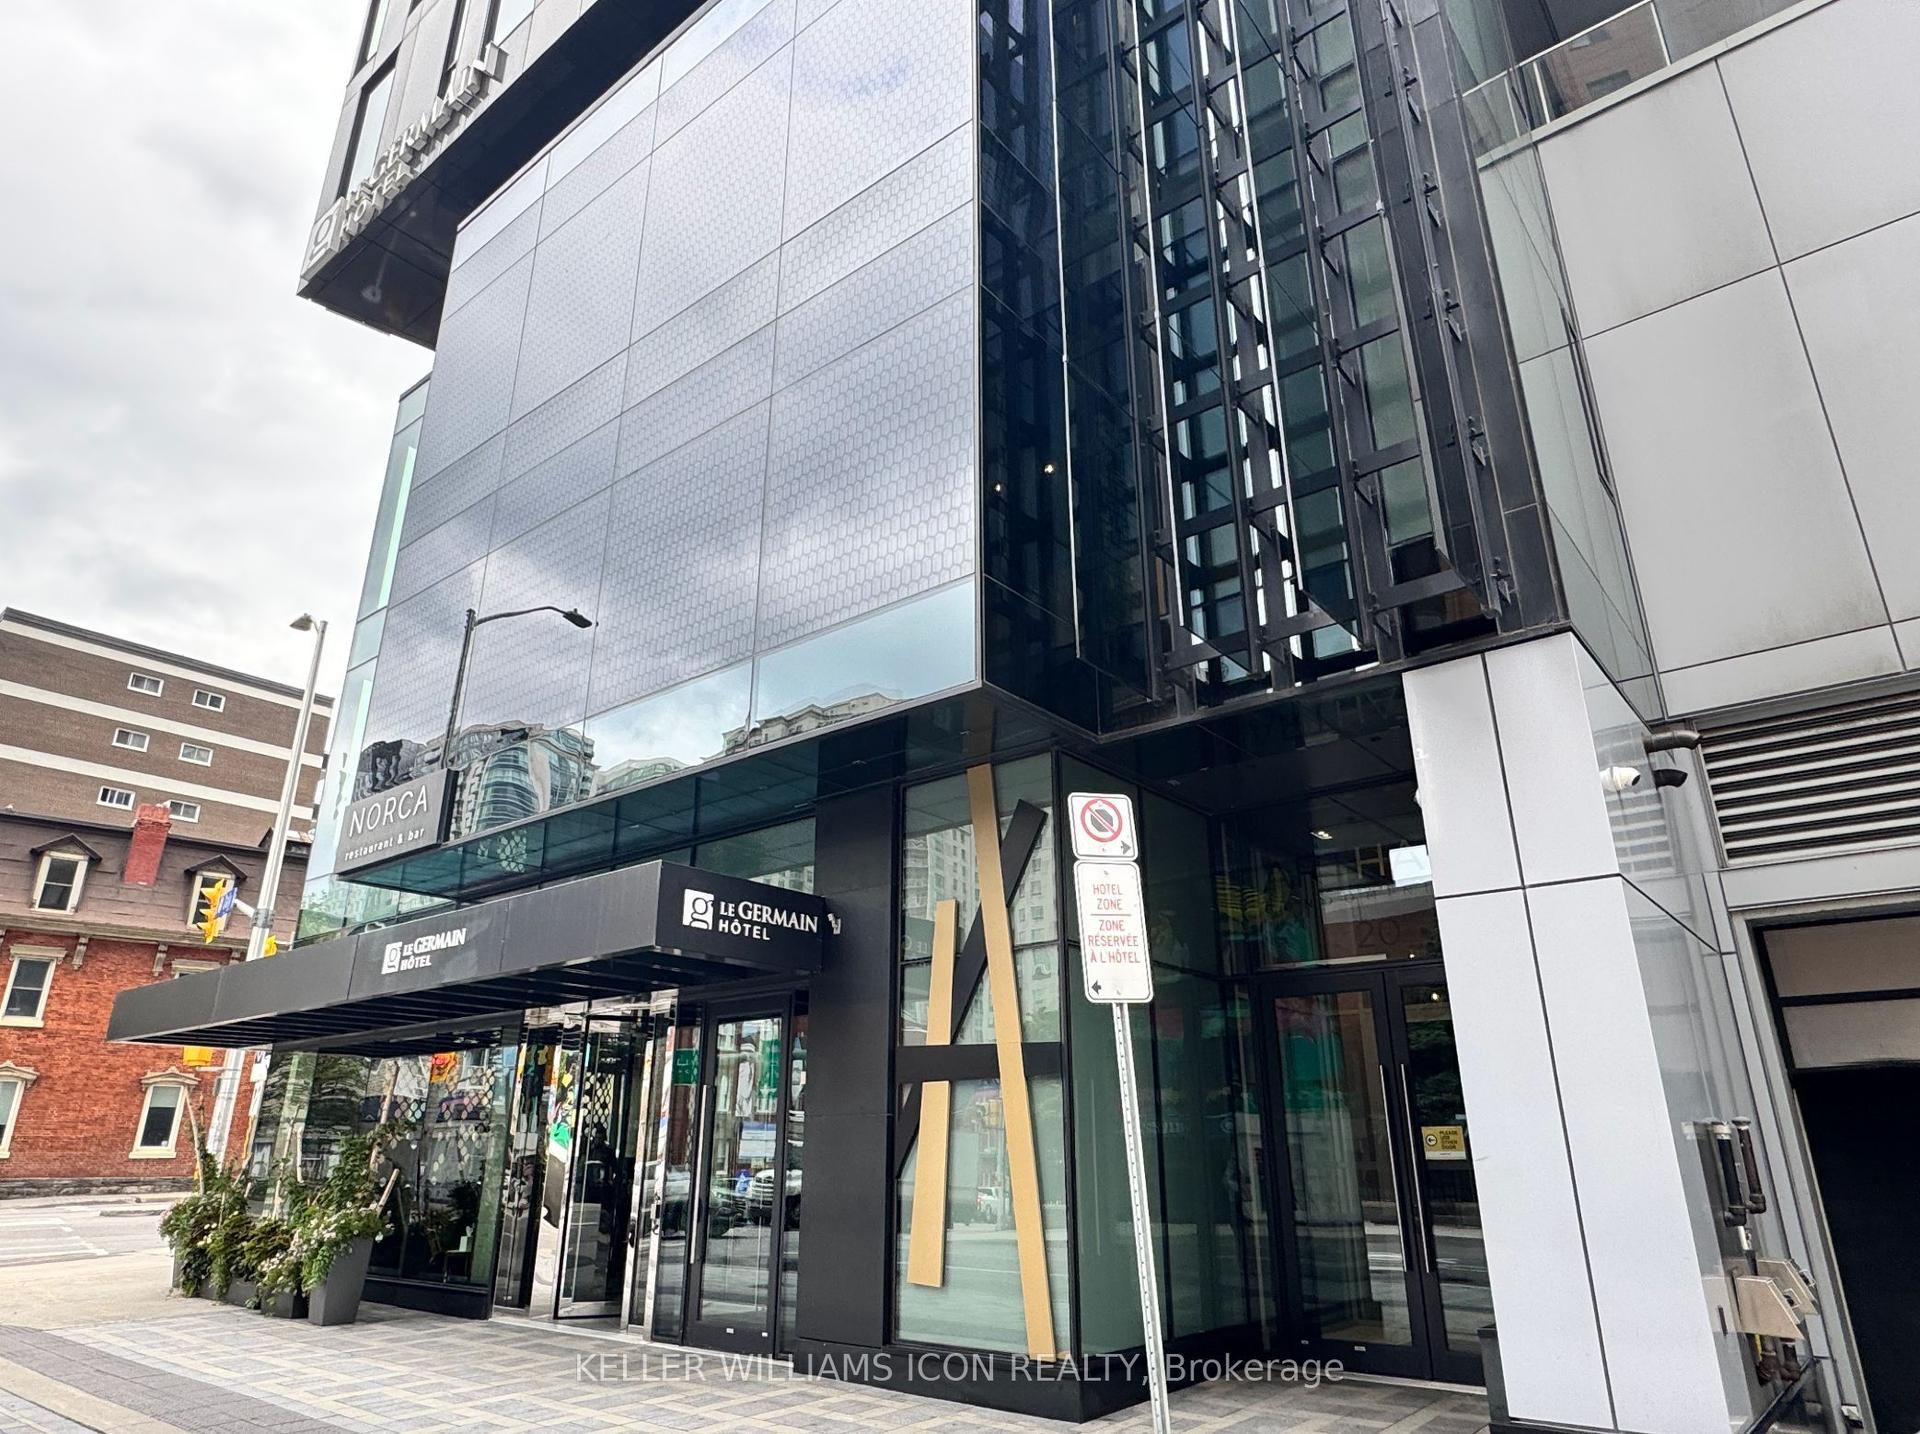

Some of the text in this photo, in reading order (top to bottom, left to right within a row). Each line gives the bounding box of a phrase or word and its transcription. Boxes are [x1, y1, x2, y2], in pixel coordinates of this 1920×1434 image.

[349, 785, 428, 838] NORCA
[344, 837, 393, 861] restaurant
[408, 828, 425, 841] bar
[1093, 883, 1123, 896] HOTEL
[1097, 898, 1123, 911] ZONE
[719, 901, 818, 933] LE GERMAIN
[718, 918, 771, 941] HÔTEL
[1099, 919, 1125, 932] ZONE
[402, 928, 467, 957] LE GERMAIN
[1088, 932, 1139, 947] RÉSERVÉE
[400, 955, 432, 971] HÔTEL
[1090, 948, 1098, 963] À
